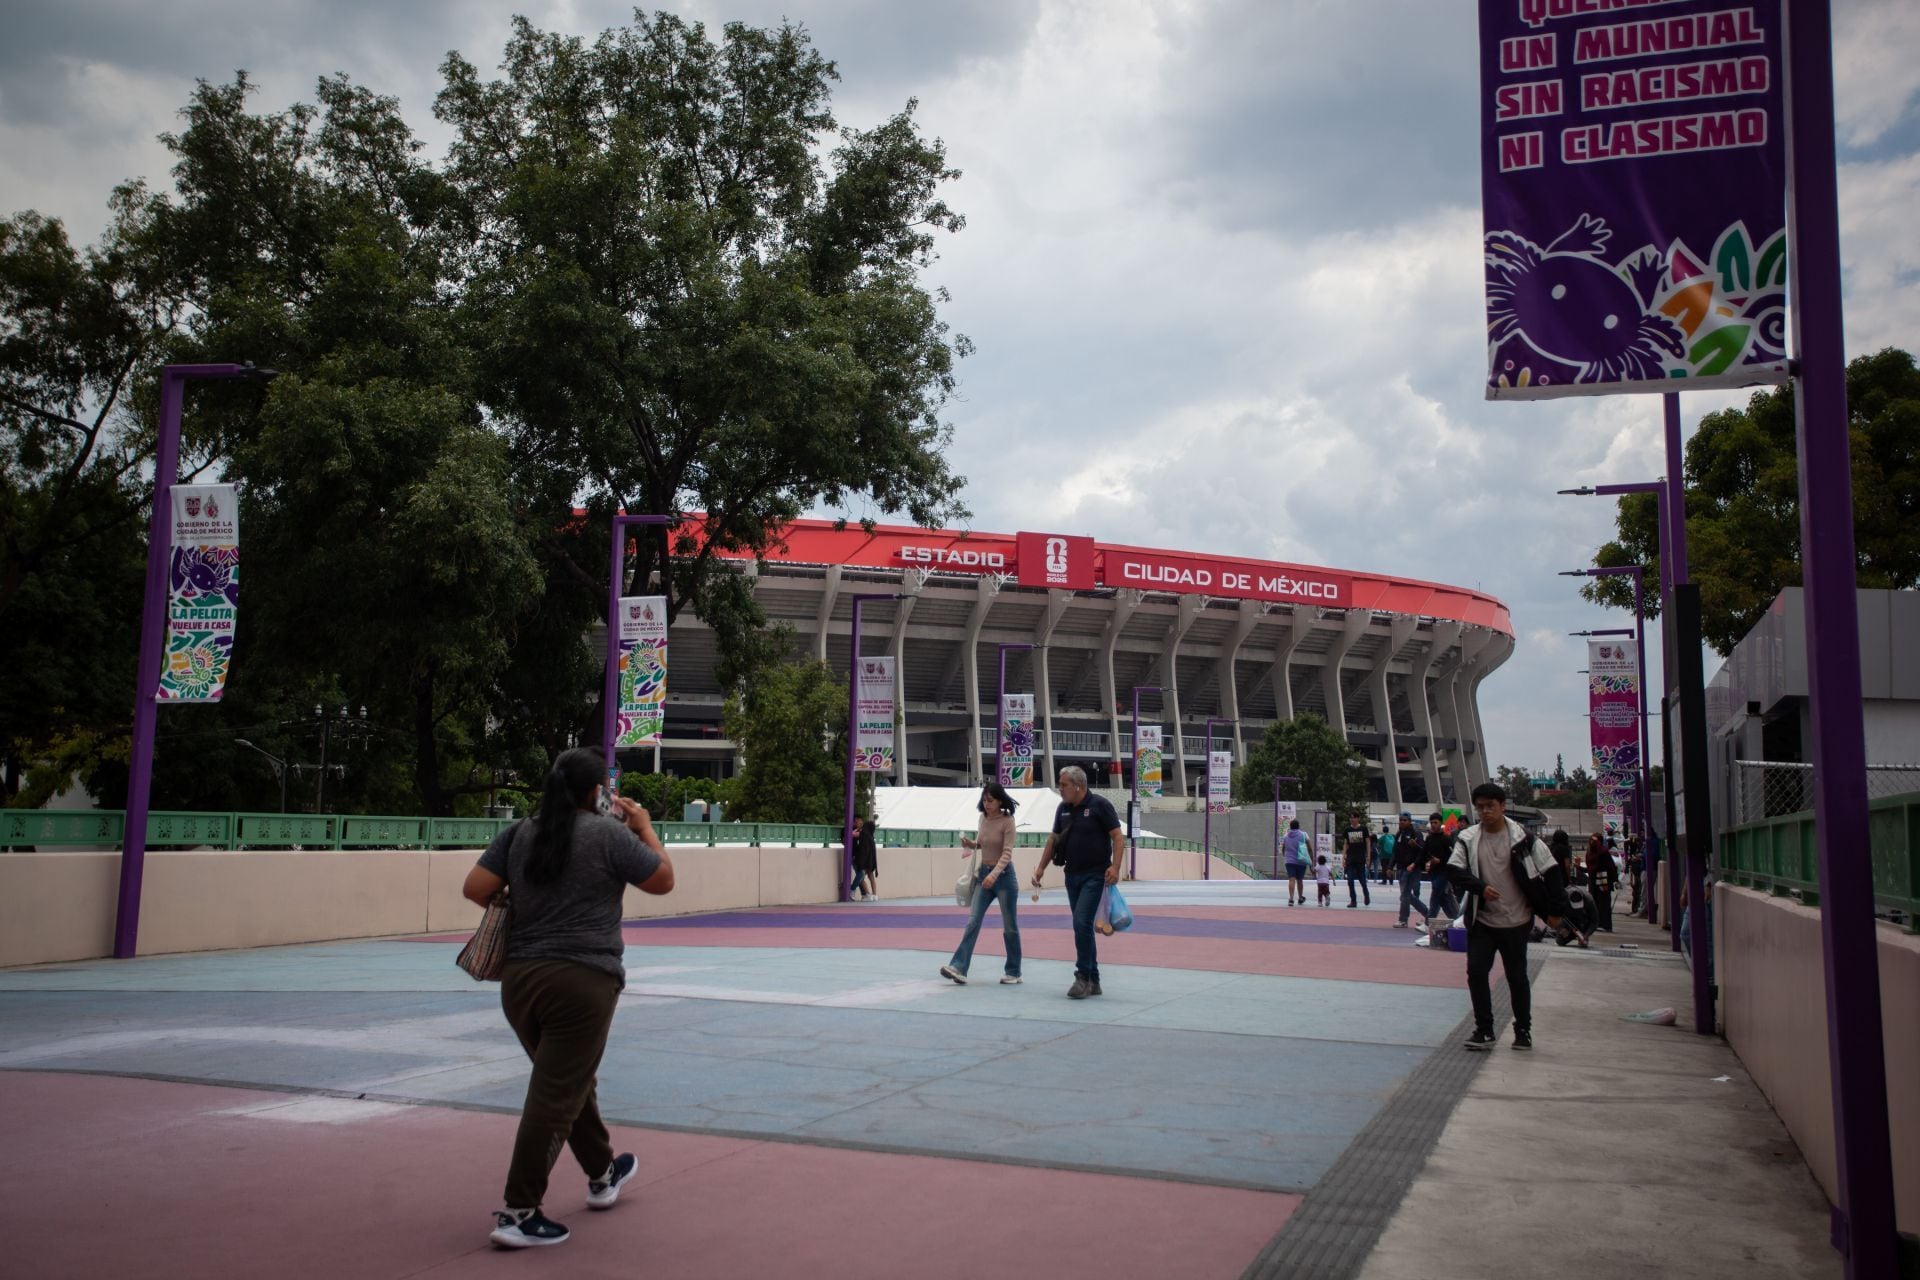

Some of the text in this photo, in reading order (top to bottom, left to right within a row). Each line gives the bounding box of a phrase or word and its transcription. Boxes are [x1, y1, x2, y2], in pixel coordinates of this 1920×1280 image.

[1501, 34, 1555, 72] UN
[1575, 8, 1763, 63] MUNDIAL
[1497, 56, 1768, 121] SIN RACISMO
[1501, 109, 1766, 172] NI CLASISMO
[901, 546, 1004, 567] ESTADIO
[1124, 562, 1338, 599] CIUDAD DE MÉXICO
[172, 608, 232, 619] LA PELOTA
[172, 622, 230, 630] VUELVE A CASA
